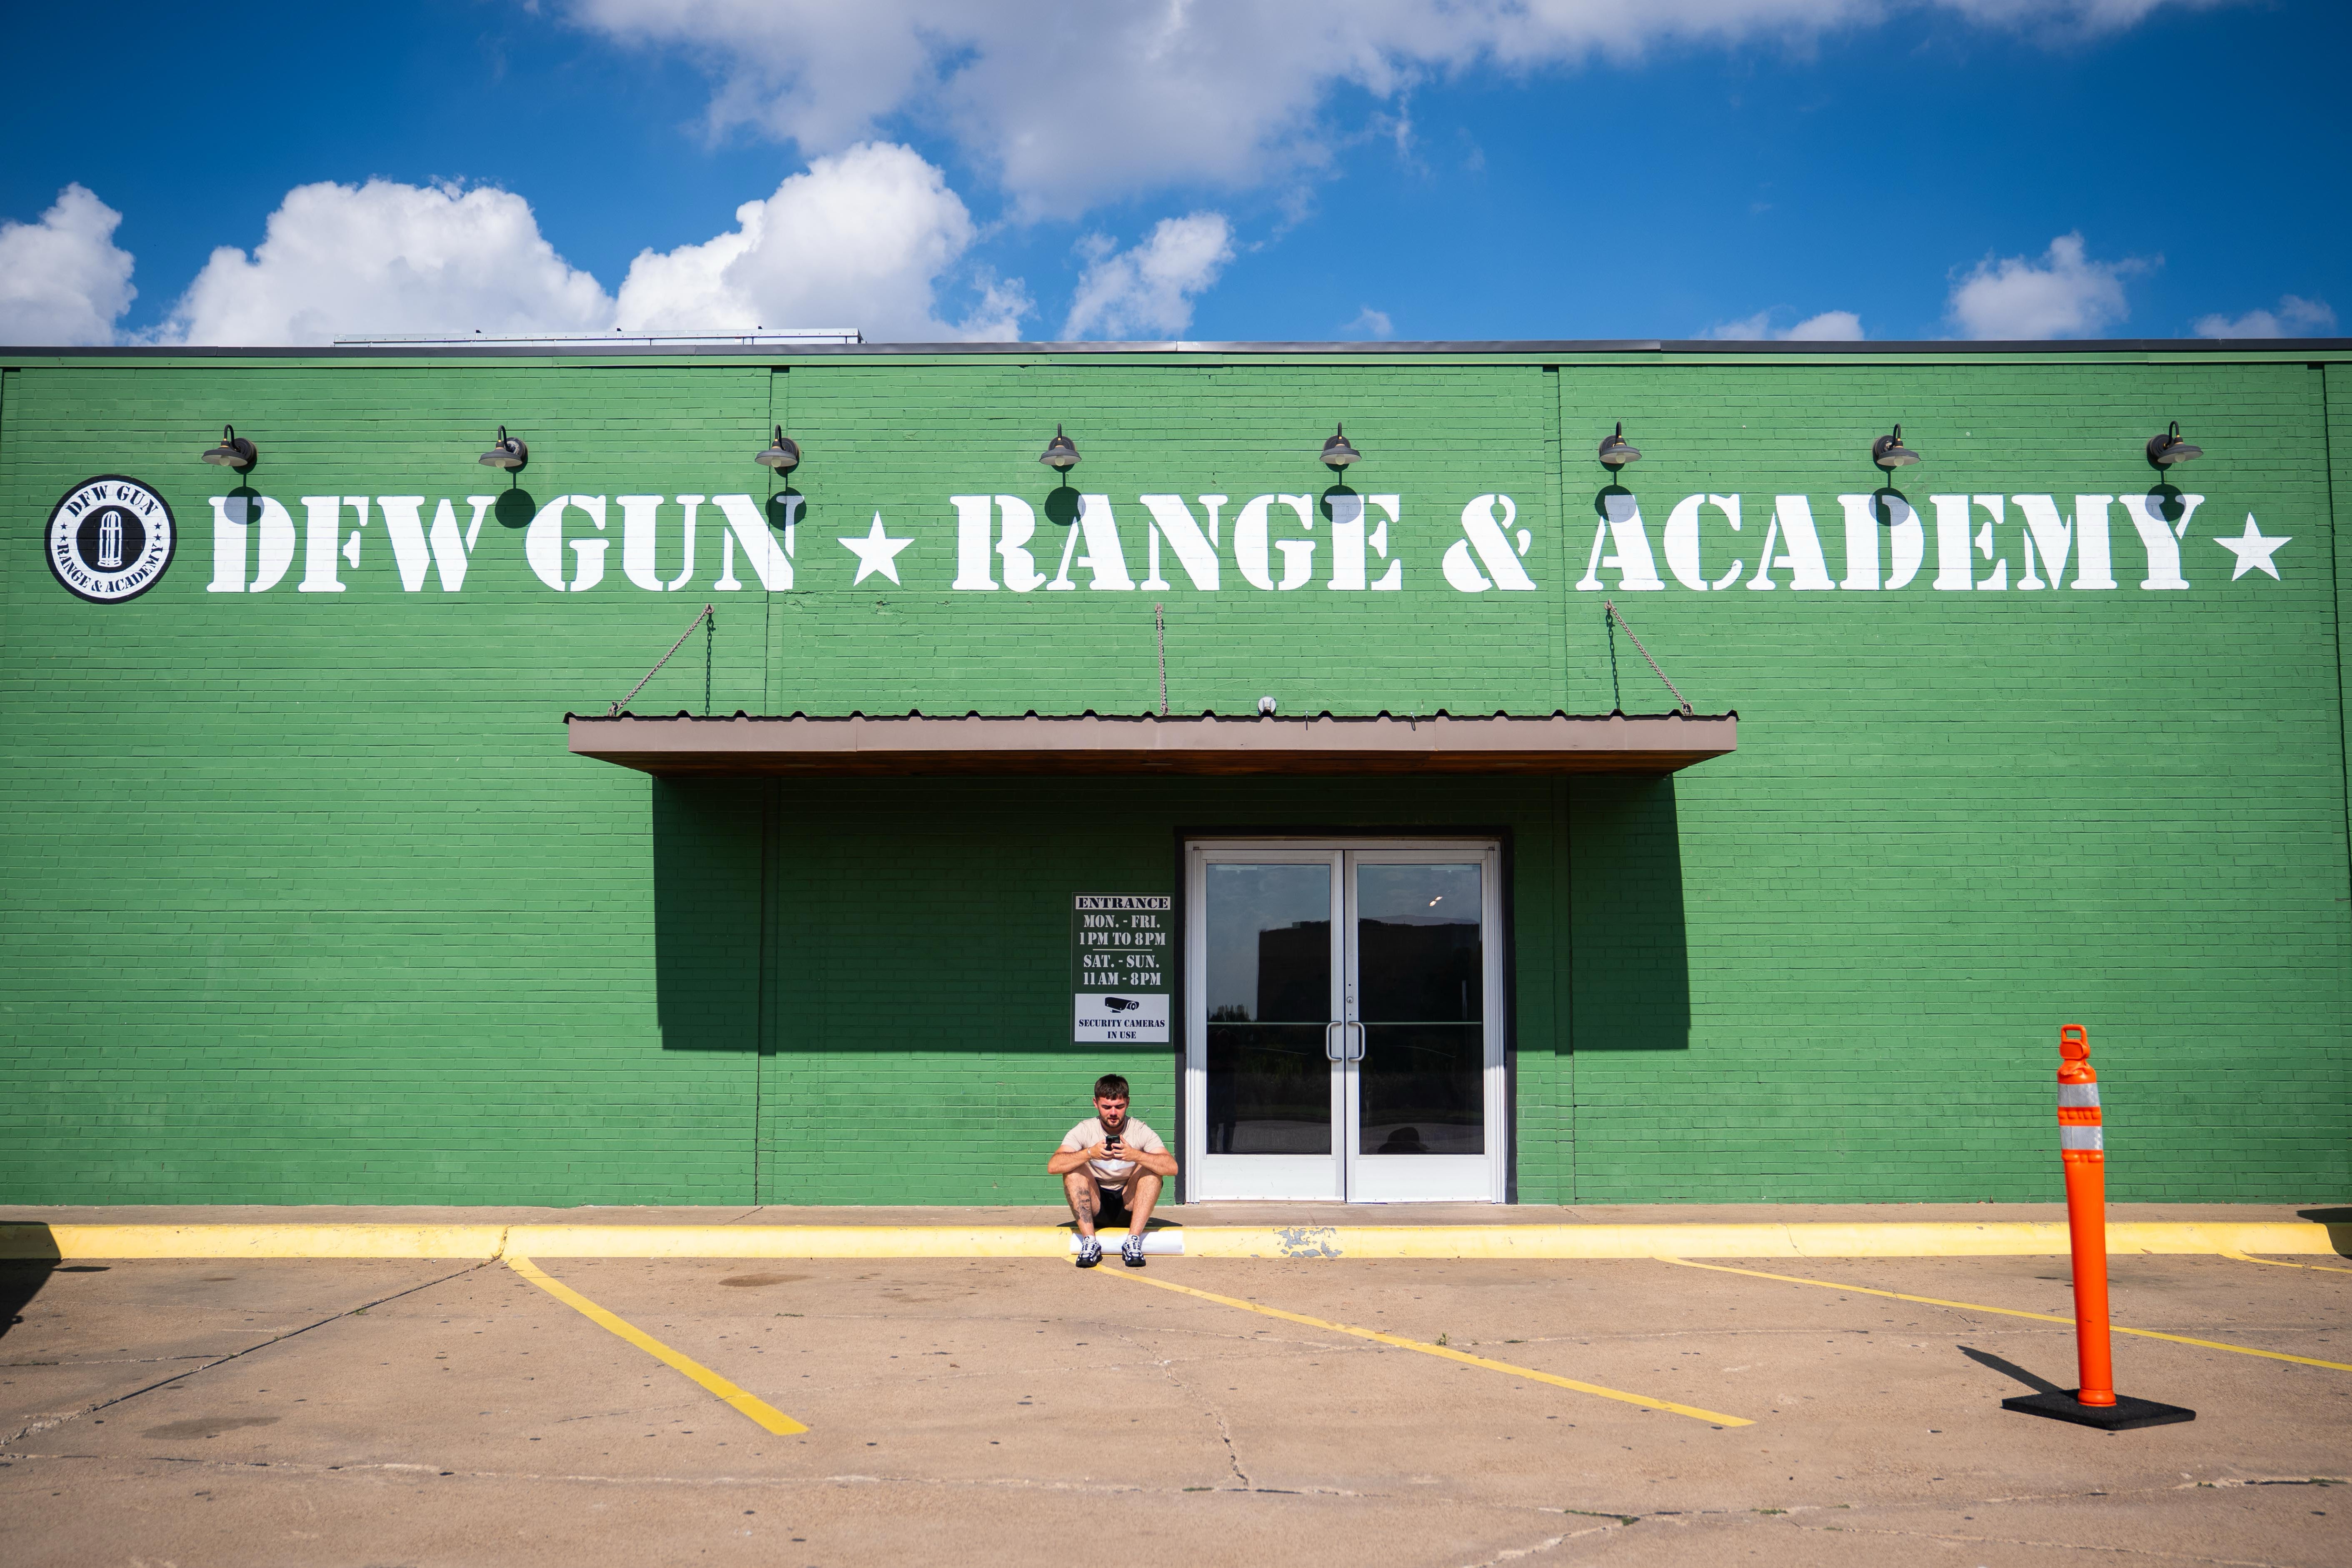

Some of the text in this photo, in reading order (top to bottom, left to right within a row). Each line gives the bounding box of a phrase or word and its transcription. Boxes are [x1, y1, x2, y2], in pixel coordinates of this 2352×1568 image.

[65, 485, 158, 517] DFW GUN
[207, 494, 2205, 593] DFW GUN RANGE & ACADEMY
[57, 543, 163, 592] RANGE & ACADEMY
[1078, 897, 1168, 909] ENTRANCE
[1084, 915, 1119, 928] MON.
[1131, 915, 1160, 928] FRI.
[1113, 932, 1131, 945] TO
[1135, 932, 1166, 945] 8PM
[1084, 955, 1114, 968] SAT.
[1126, 955, 1159, 968] SUN.
[1130, 972, 1161, 985] 8PM
[1079, 1019, 1122, 1027] SECURITY
